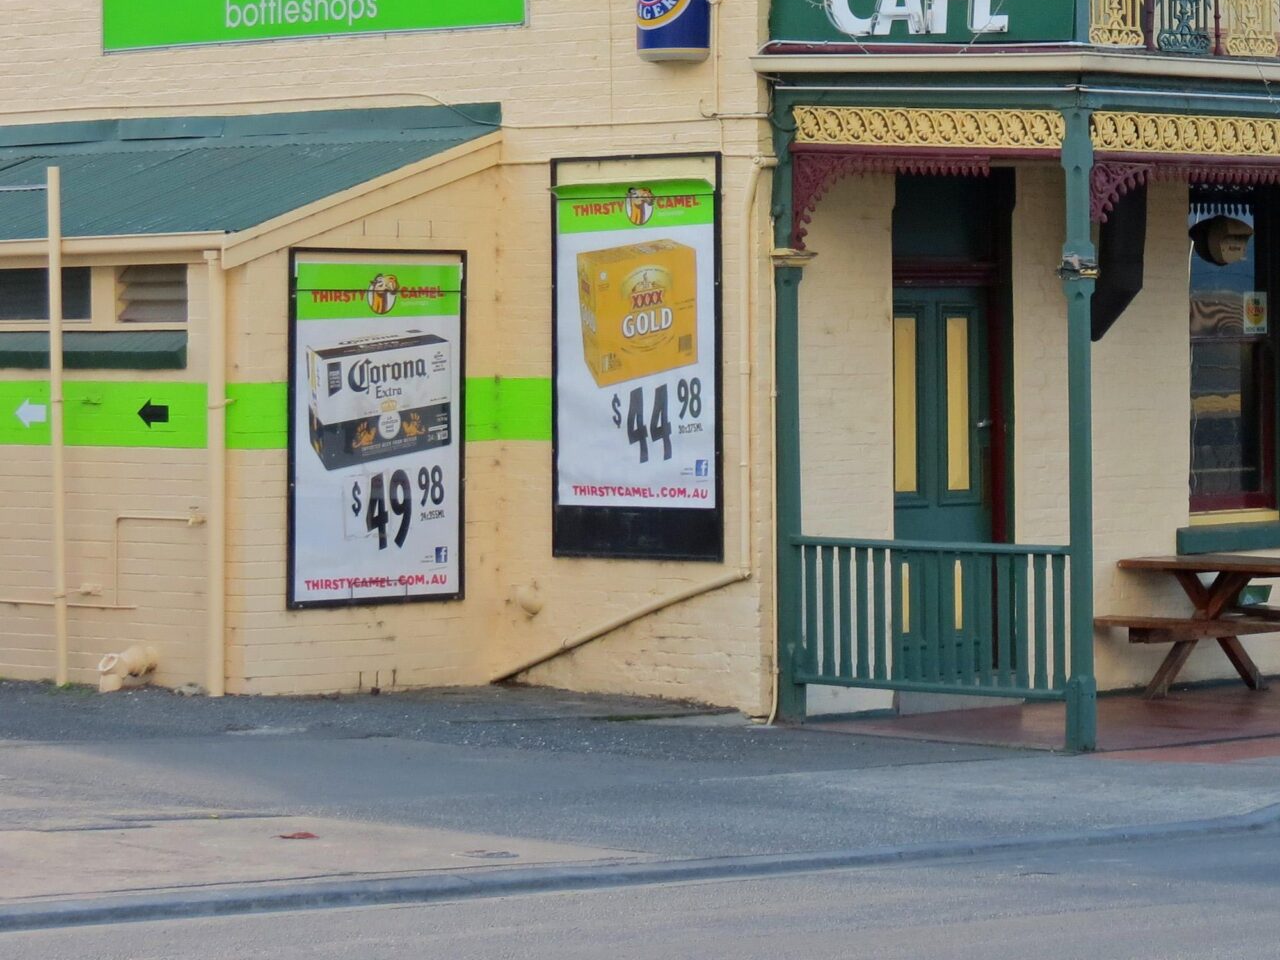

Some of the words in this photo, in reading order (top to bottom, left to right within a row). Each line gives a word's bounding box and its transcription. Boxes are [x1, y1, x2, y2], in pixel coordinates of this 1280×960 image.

[572, 201, 625, 217] THIRSTY
[656, 194, 701, 209] CAMEL
[312, 289, 366, 303] THIRSTY
[401, 285, 446, 299] CAMEL
[631, 290, 664, 309] XXXX
[622, 307, 673, 339] GOLD
[348, 358, 427, 395] Corona
[375, 385, 402, 399] Extra
[572, 485, 708, 499] THIRSTYCAMEL.COM.AU
[304, 573, 447, 591] THIRSTYCAMEL.COM.AU
